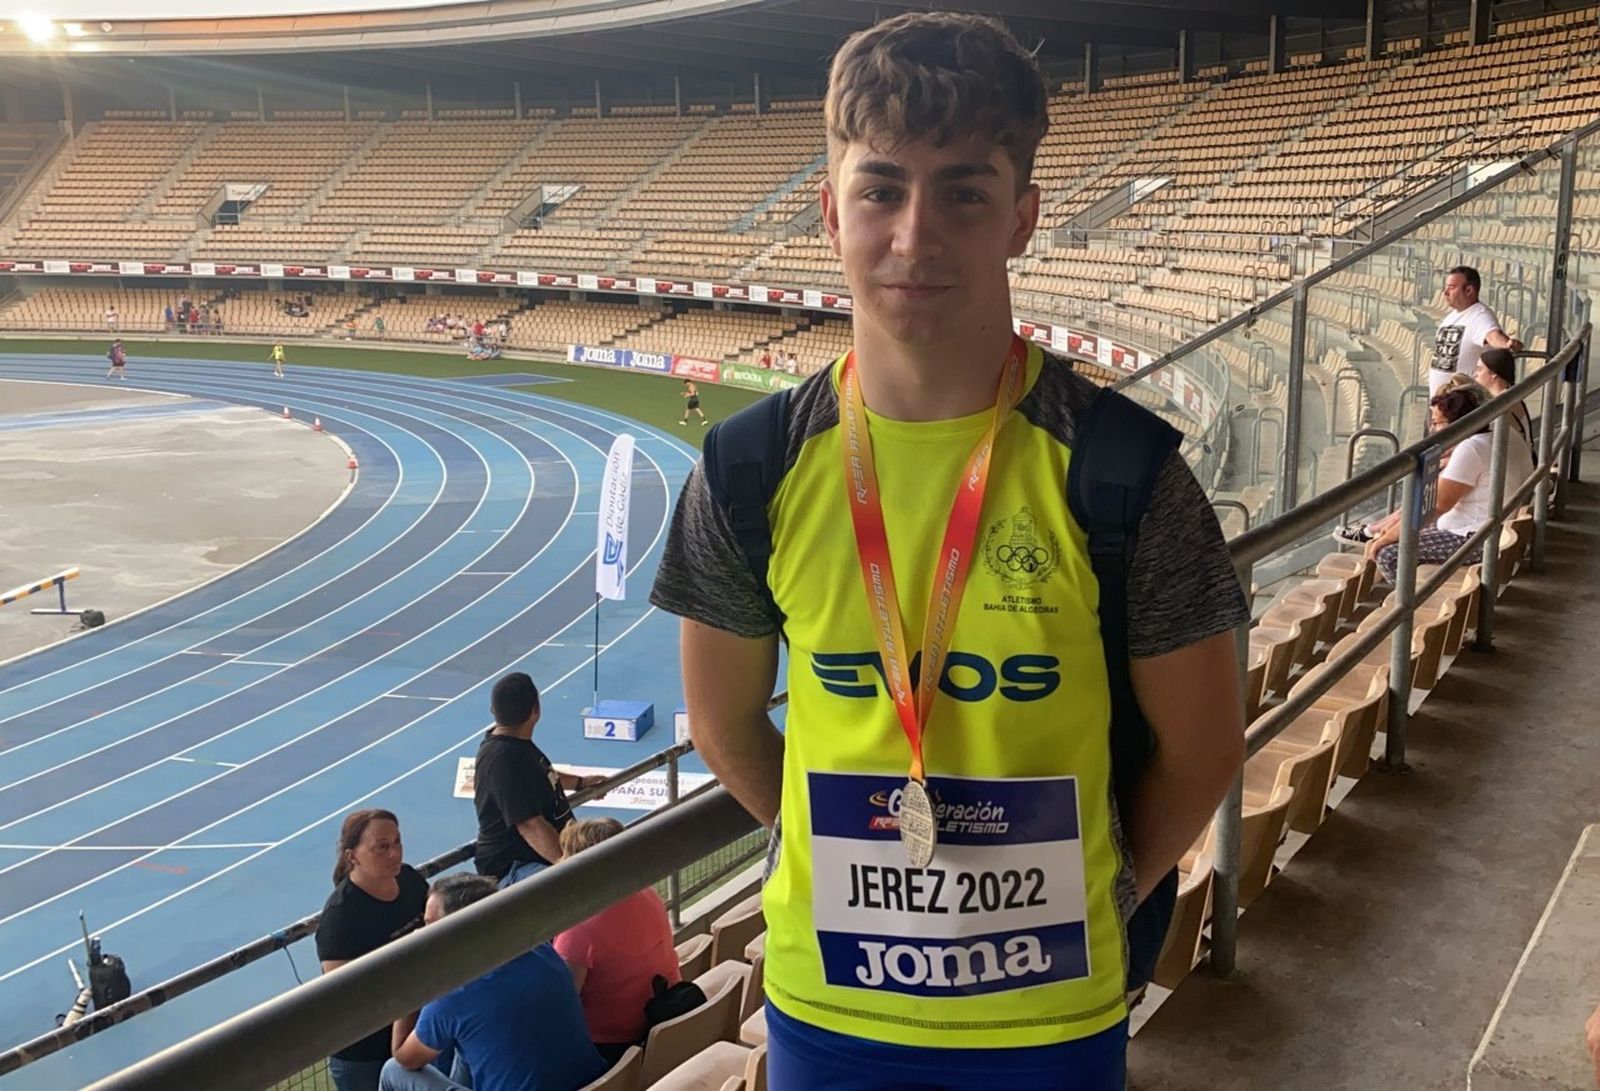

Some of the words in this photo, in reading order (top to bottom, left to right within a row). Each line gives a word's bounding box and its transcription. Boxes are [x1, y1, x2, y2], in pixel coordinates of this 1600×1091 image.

[580, 345, 616, 364] Joma
[810, 651, 1062, 702] EVOS
[604, 721, 616, 737] 2
[847, 863, 949, 915] JEREZ
[956, 867, 1047, 915] 2022
[855, 934, 1052, 988] Joma
